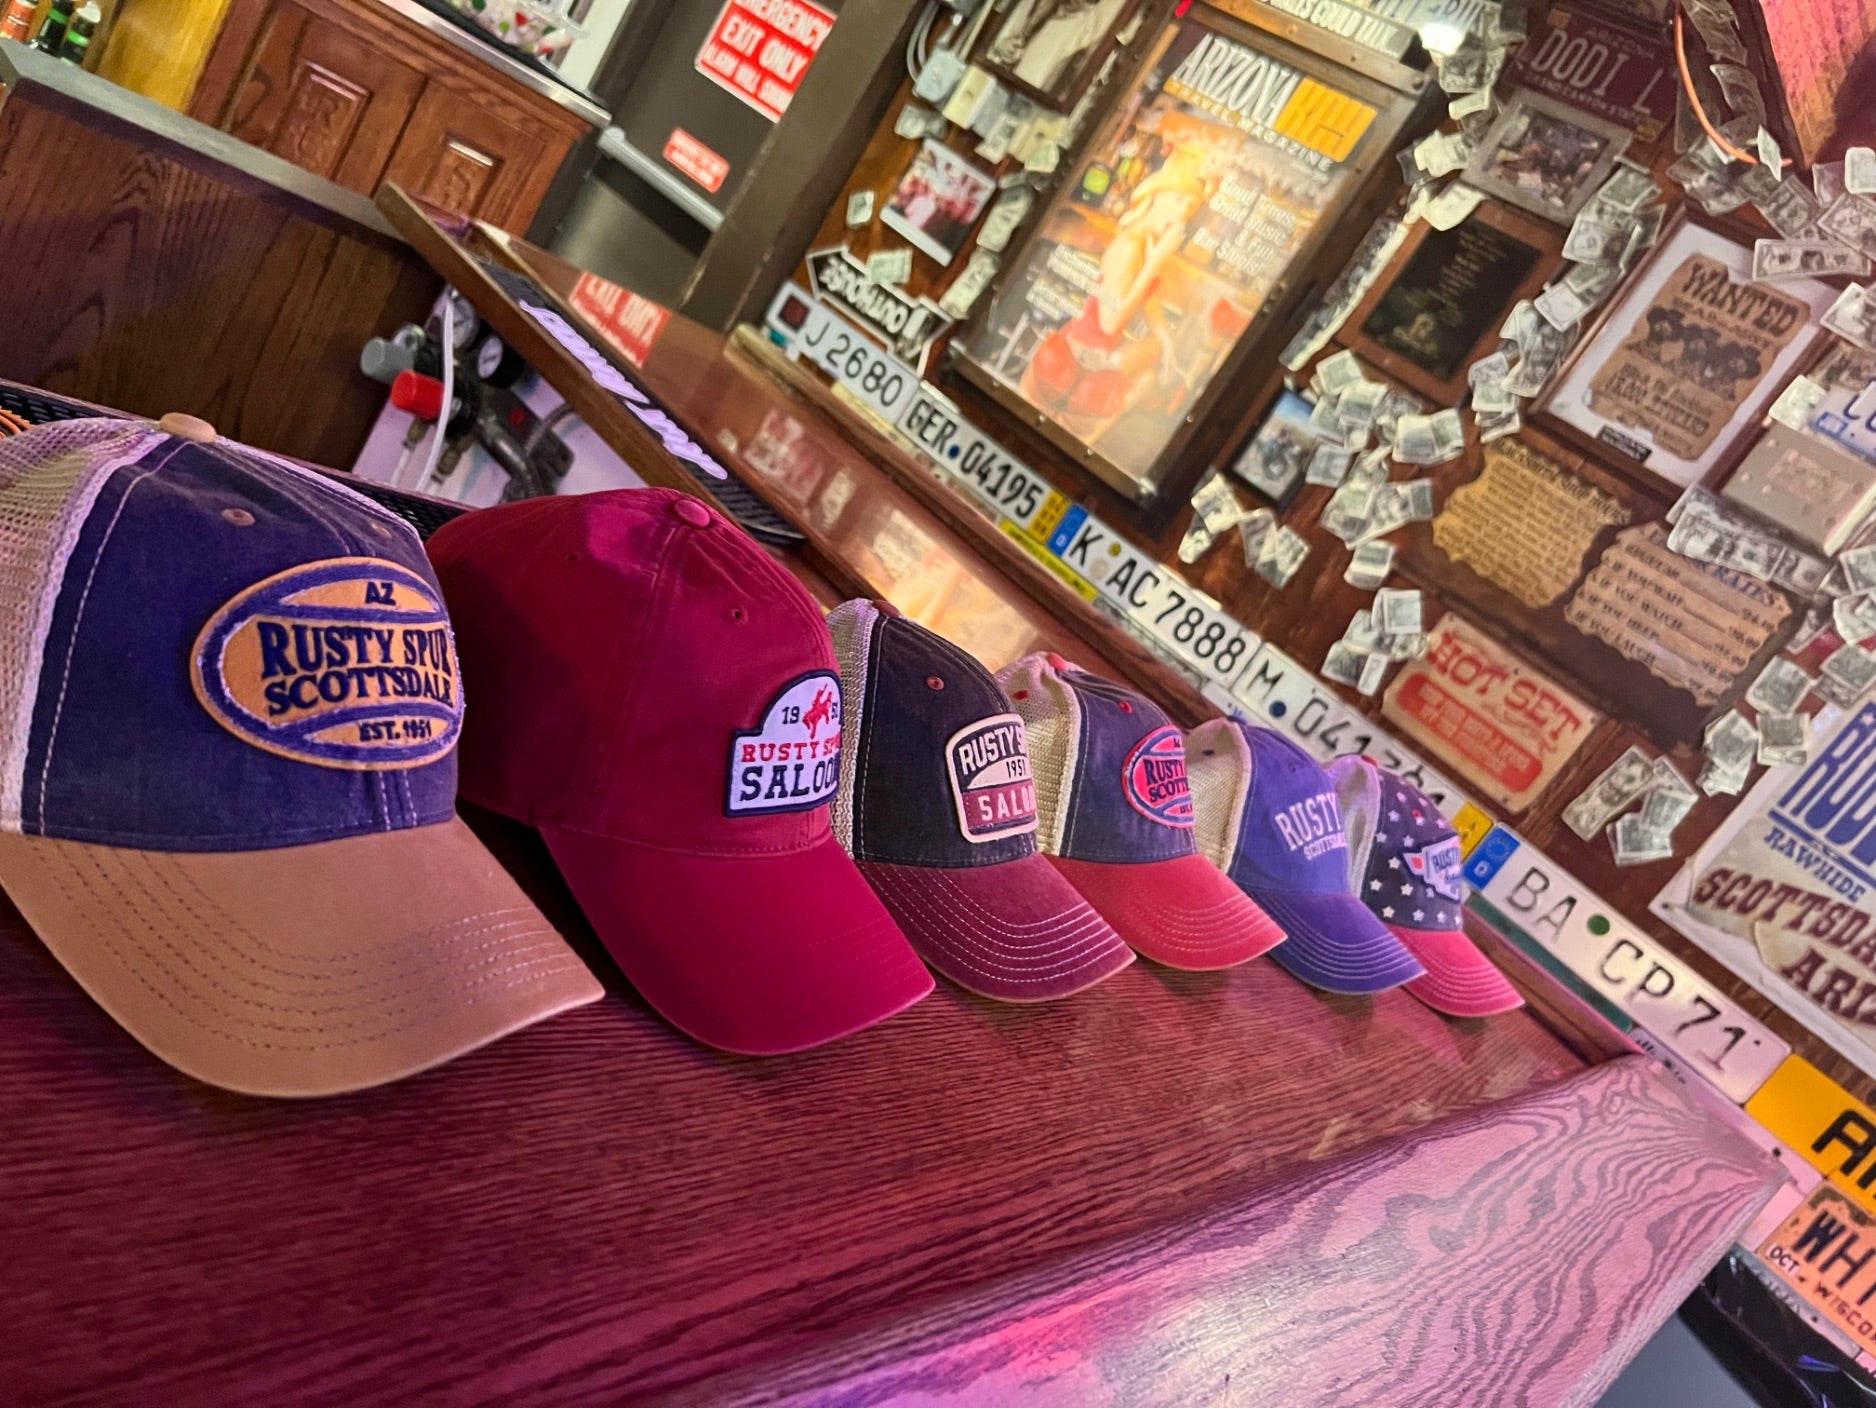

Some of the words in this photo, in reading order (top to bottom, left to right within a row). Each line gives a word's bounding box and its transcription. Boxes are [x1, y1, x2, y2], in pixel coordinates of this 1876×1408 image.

[720, 14, 766, 57] EXIT
[758, 38, 809, 84] ONLY
[733, 0, 834, 52] ERGENCY
[1172, 33, 1299, 131] ARIZONA
[1237, 116, 1334, 172] MAGAZINE
[817, 257, 909, 334] OUTHOUSE
[1681, 262, 1800, 337] WANTED
[804, 321, 831, 348] J
[826, 333, 905, 408] 2680
[905, 400, 959, 455] GER
[959, 440, 1047, 521] 04195
[364, 581, 397, 606] AZ
[1069, 528, 1104, 567] K
[1105, 553, 1161, 609] AC
[1153, 591, 1248, 675] 7888
[257, 621, 395, 680] RUSTY
[402, 625, 453, 677] SPUR
[1252, 658, 1287, 695] M
[264, 665, 454, 717] SCOTTSDALE
[781, 705, 801, 725] 19
[1426, 632, 1510, 697] HOT
[1503, 679, 1582, 741] SET
[358, 721, 401, 742] EST.
[741, 741, 818, 763] RUSTY
[958, 725, 1016, 776] RUSTY
[1006, 759, 1027, 778] 1951
[1142, 758, 1186, 786] RUSTY
[1274, 791, 1343, 850] RUSTY
[1431, 845, 1461, 873] RUST
[1763, 827, 1867, 903] RAWHIDE
[1505, 865, 1578, 945] BA
[1598, 937, 1676, 1007] CP
[1672, 996, 1751, 1077] 71
[1769, 1245, 1800, 1273] OCT
[1816, 1280, 1876, 1344] WISCO
